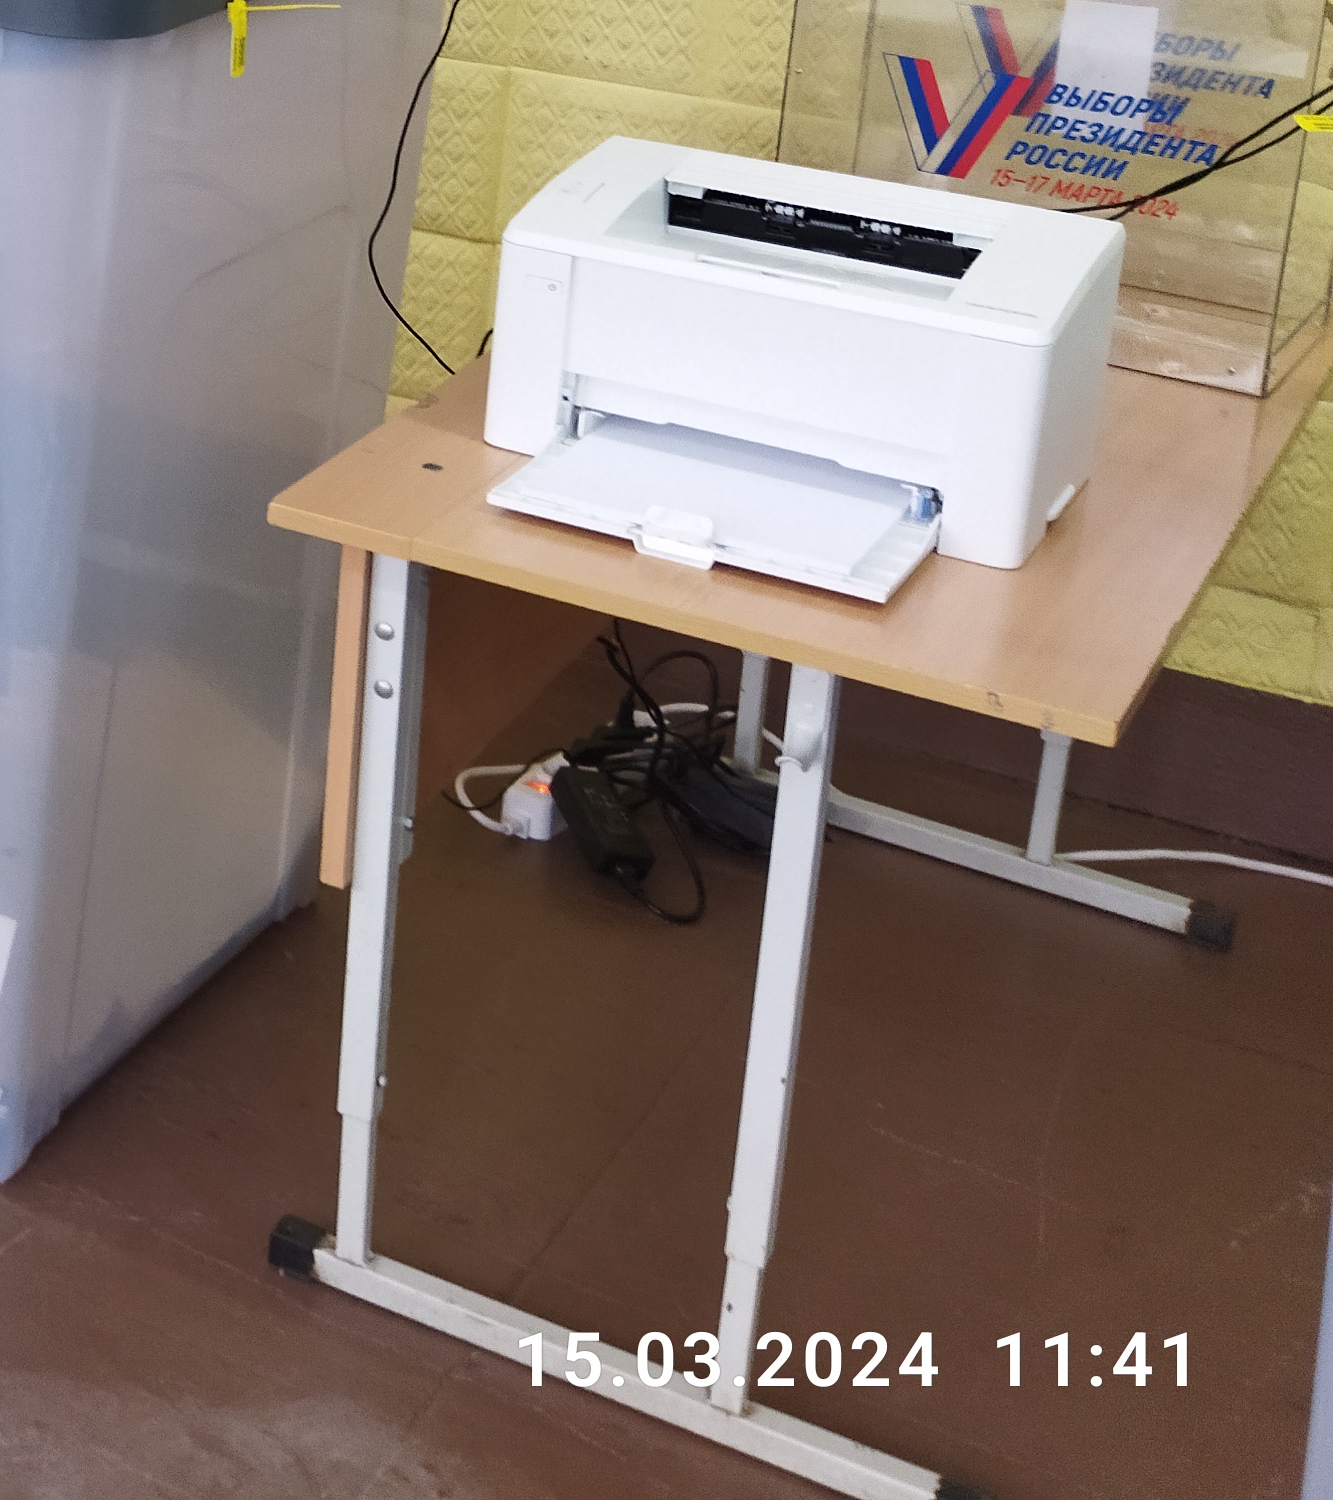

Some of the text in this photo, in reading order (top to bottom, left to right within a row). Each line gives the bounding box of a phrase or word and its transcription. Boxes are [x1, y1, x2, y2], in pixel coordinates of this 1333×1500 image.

[1155, 31, 1242, 62] БОРЫ
[1150, 61, 1277, 100] ЗИДЕНТА
[1044, 82, 1184, 125] ВЫБОРЫ
[1024, 111, 1220, 168] ПРЕЗИДЕНТА
[1004, 140, 1130, 182] РОССИИ
[1051, 178, 1124, 206] МАРТА
